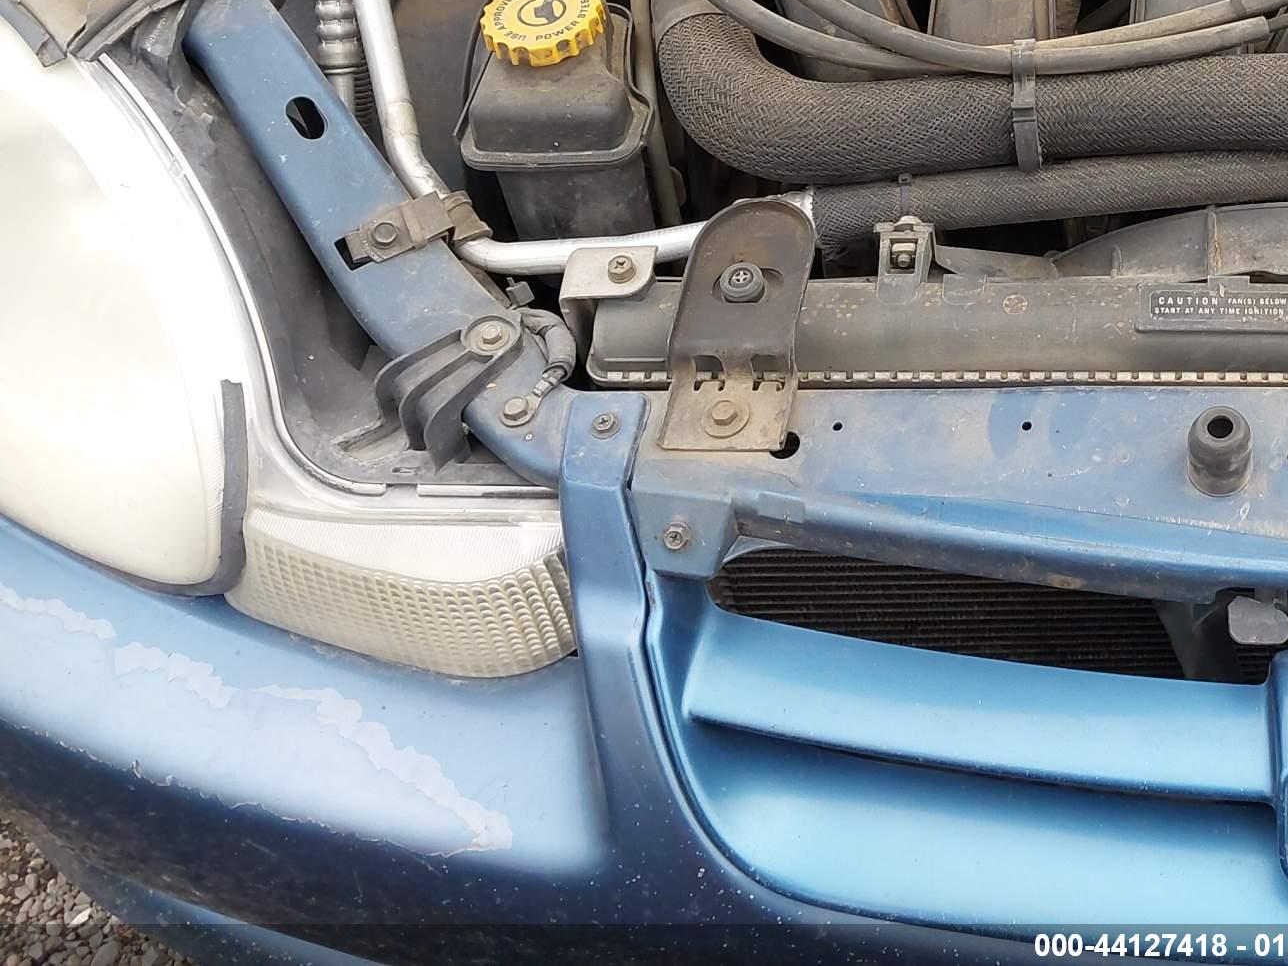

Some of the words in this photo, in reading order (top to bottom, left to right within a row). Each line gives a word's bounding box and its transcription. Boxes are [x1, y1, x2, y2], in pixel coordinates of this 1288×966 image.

[503, 30, 528, 42] USE
[535, 21, 581, 42] POWER
[1158, 296, 1218, 305] CAUTION
[1228, 297, 1256, 305] FAN(S)
[1259, 297, 1287, 305] BELOW
[1154, 307, 1181, 315] START
[1219, 307, 1241, 315] TIME
